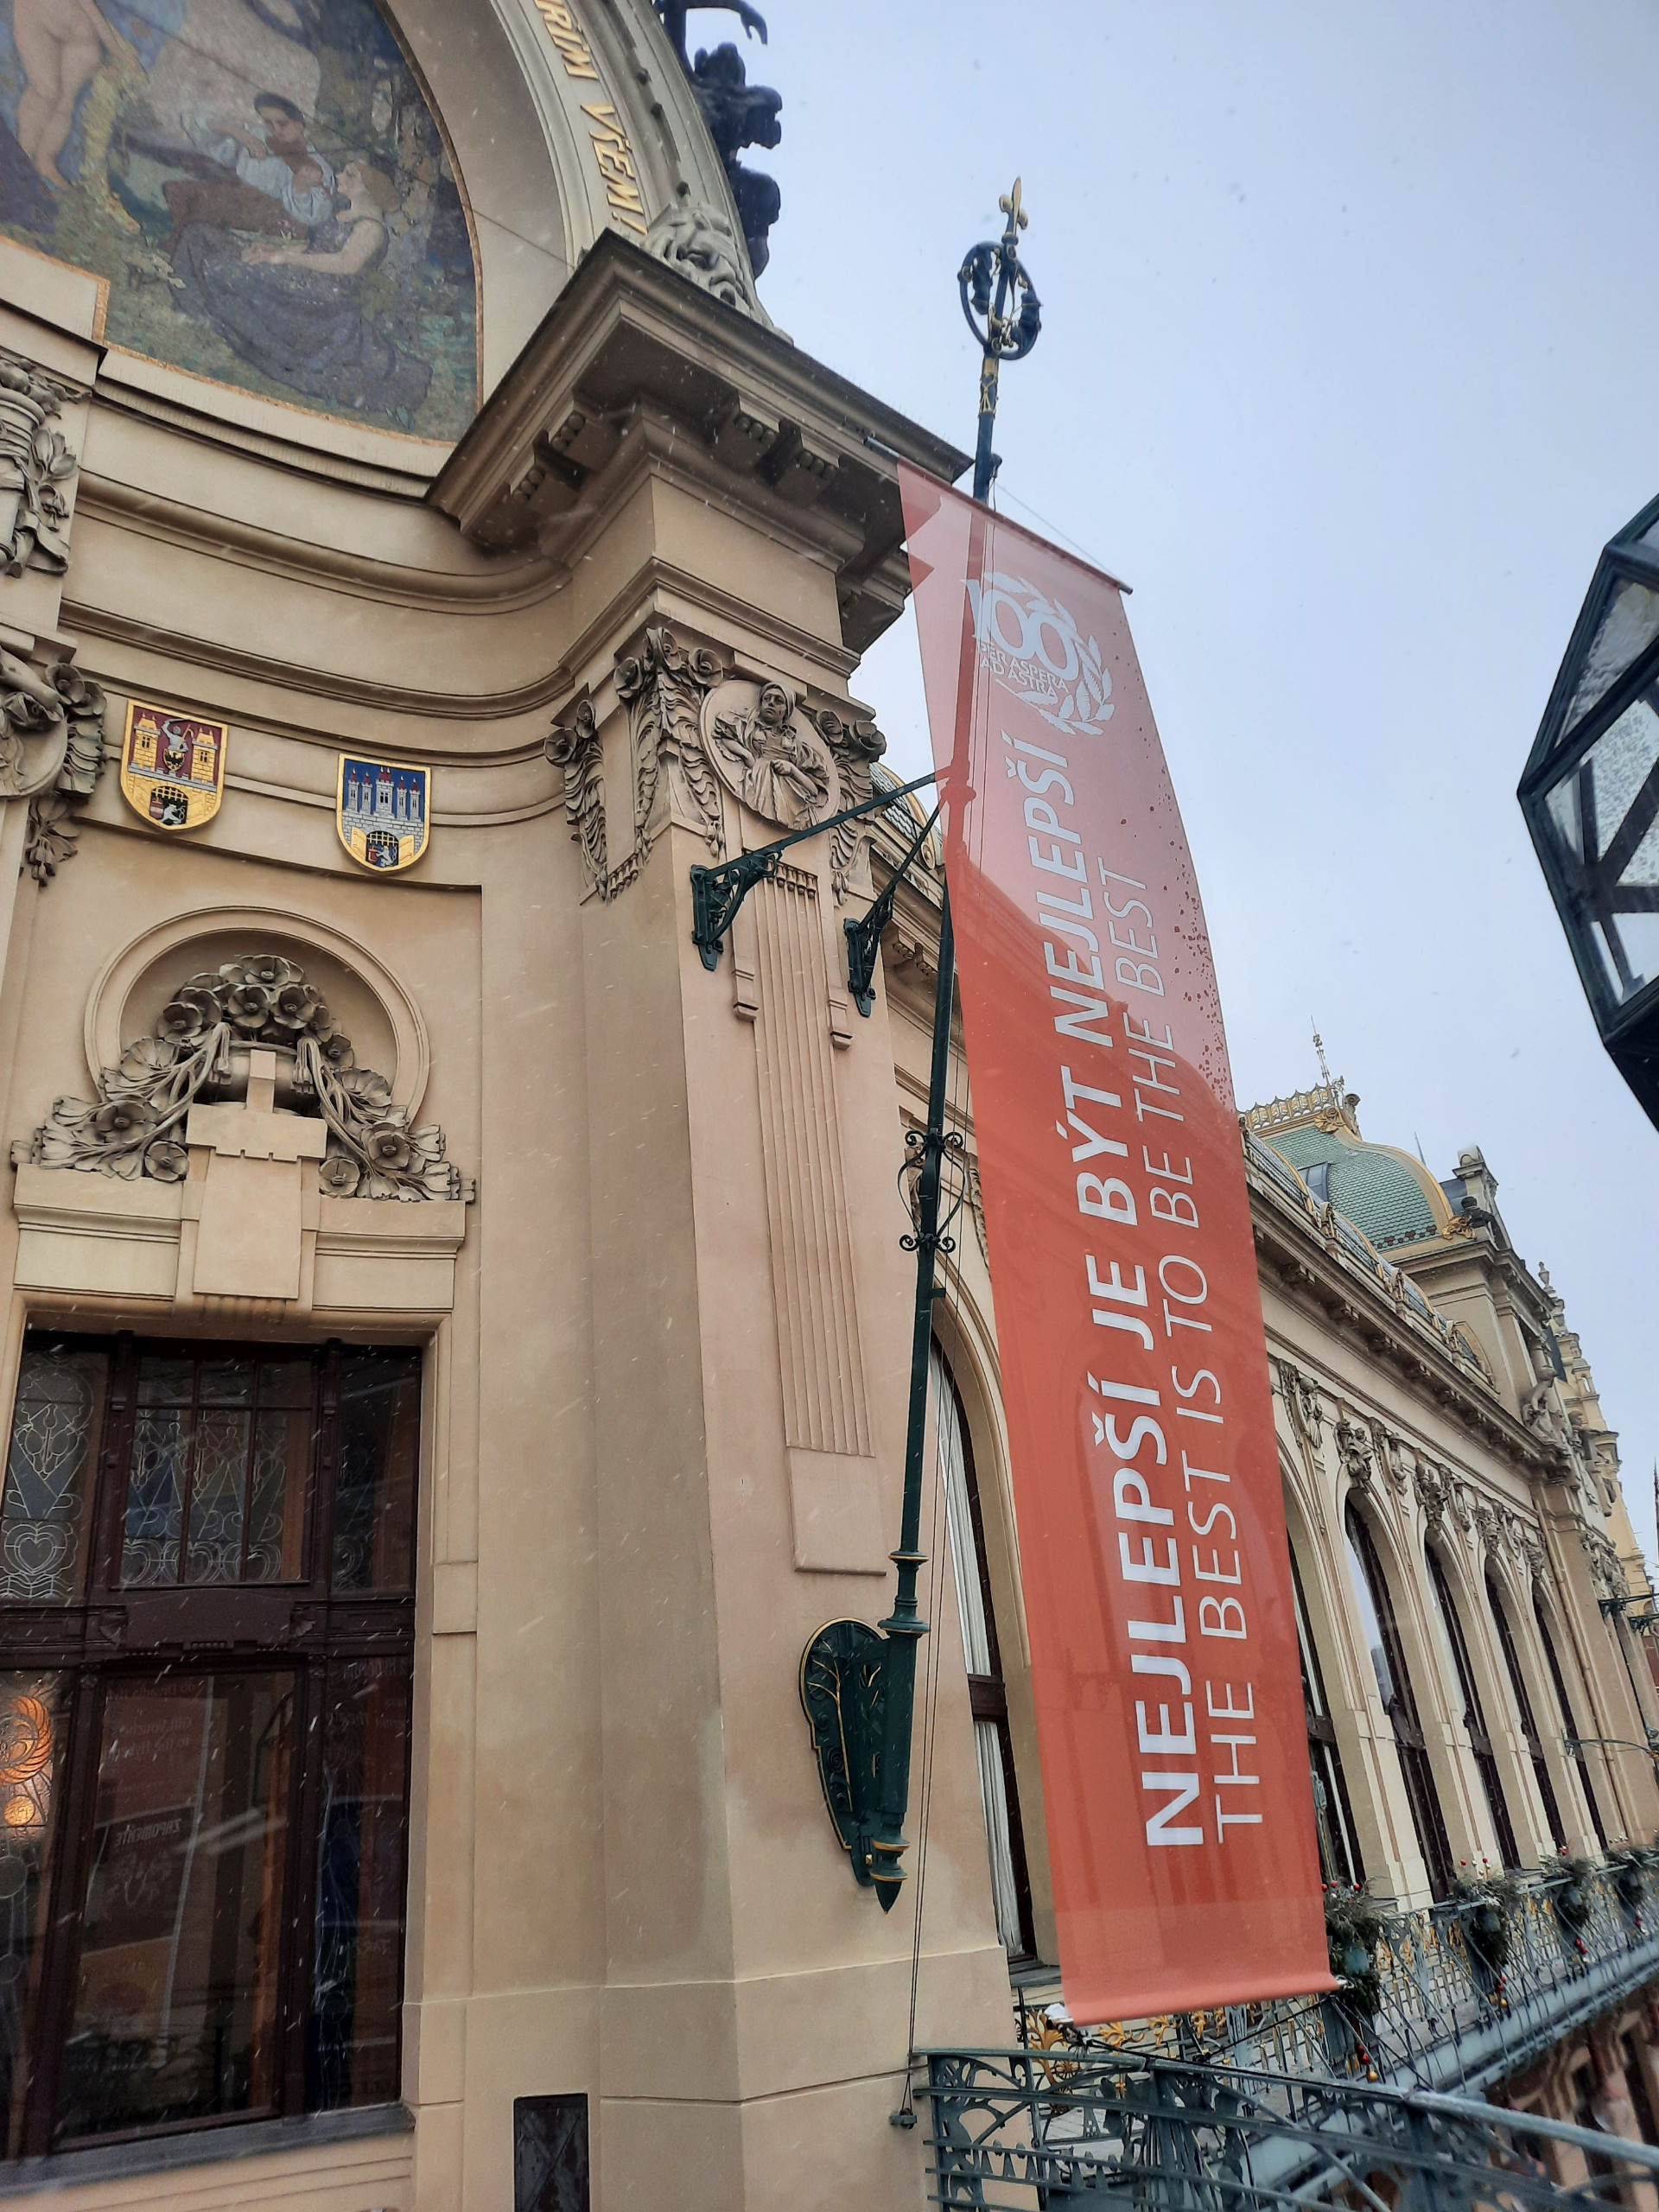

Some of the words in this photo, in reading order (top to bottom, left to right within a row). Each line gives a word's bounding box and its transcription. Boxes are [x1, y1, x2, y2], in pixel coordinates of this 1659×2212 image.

[580, 104, 649, 235] VŠEM!
[976, 639, 1010, 665] PER
[1008, 656, 1070, 694] ASPERA
[980, 654, 1006, 676] AD
[1007, 665, 1056, 697] ASTRA
[1000, 728, 1114, 1048] NEJLEPŠÍ
[1097, 856, 1165, 997] BEST
[1122, 1011, 1185, 1122] THE
[1055, 1065, 1138, 1227] BÝT
[1141, 1145, 1199, 1229] BE
[1085, 1254, 1154, 1351] JE
[1158, 1254, 1213, 1338] TO
[1171, 1364, 1224, 1424] IS
[1181, 1449, 1248, 1640] BEST
[1087, 1370, 1205, 1847] NEJLEPŠÍ
[1205, 1681, 1263, 1844] THE
